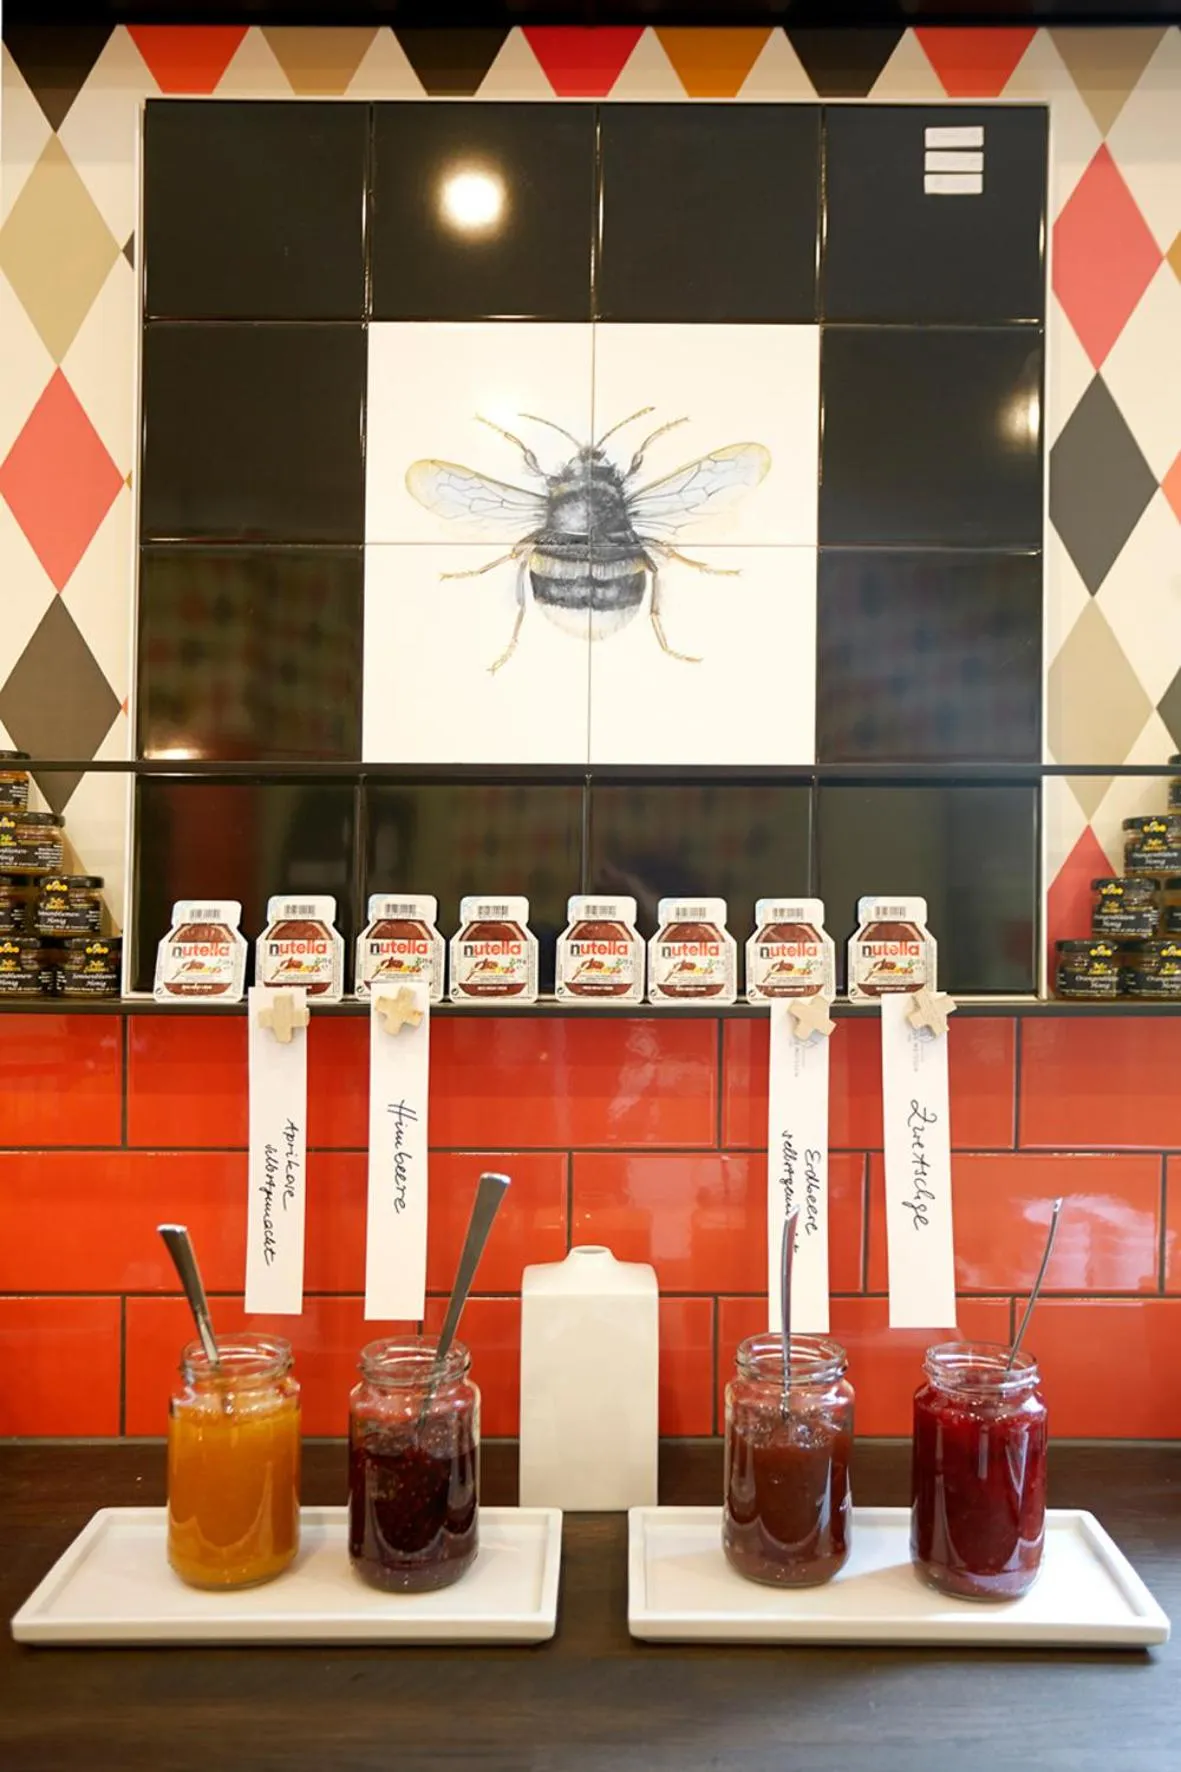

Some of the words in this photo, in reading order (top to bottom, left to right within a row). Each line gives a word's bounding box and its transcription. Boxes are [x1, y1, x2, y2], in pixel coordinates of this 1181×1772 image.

[172, 942, 230, 957] nutella
[269, 939, 327, 957] nutella
[370, 939, 428, 956] nutella
[464, 940, 521, 957] nutella
[570, 939, 628, 957] nutella
[662, 941, 720, 957] nutella
[760, 942, 817, 958] nutella
[862, 940, 919, 957] nutella
[387, 1099, 418, 1214] Himbeere
[804, 1146, 821, 1237] Erdbeere
